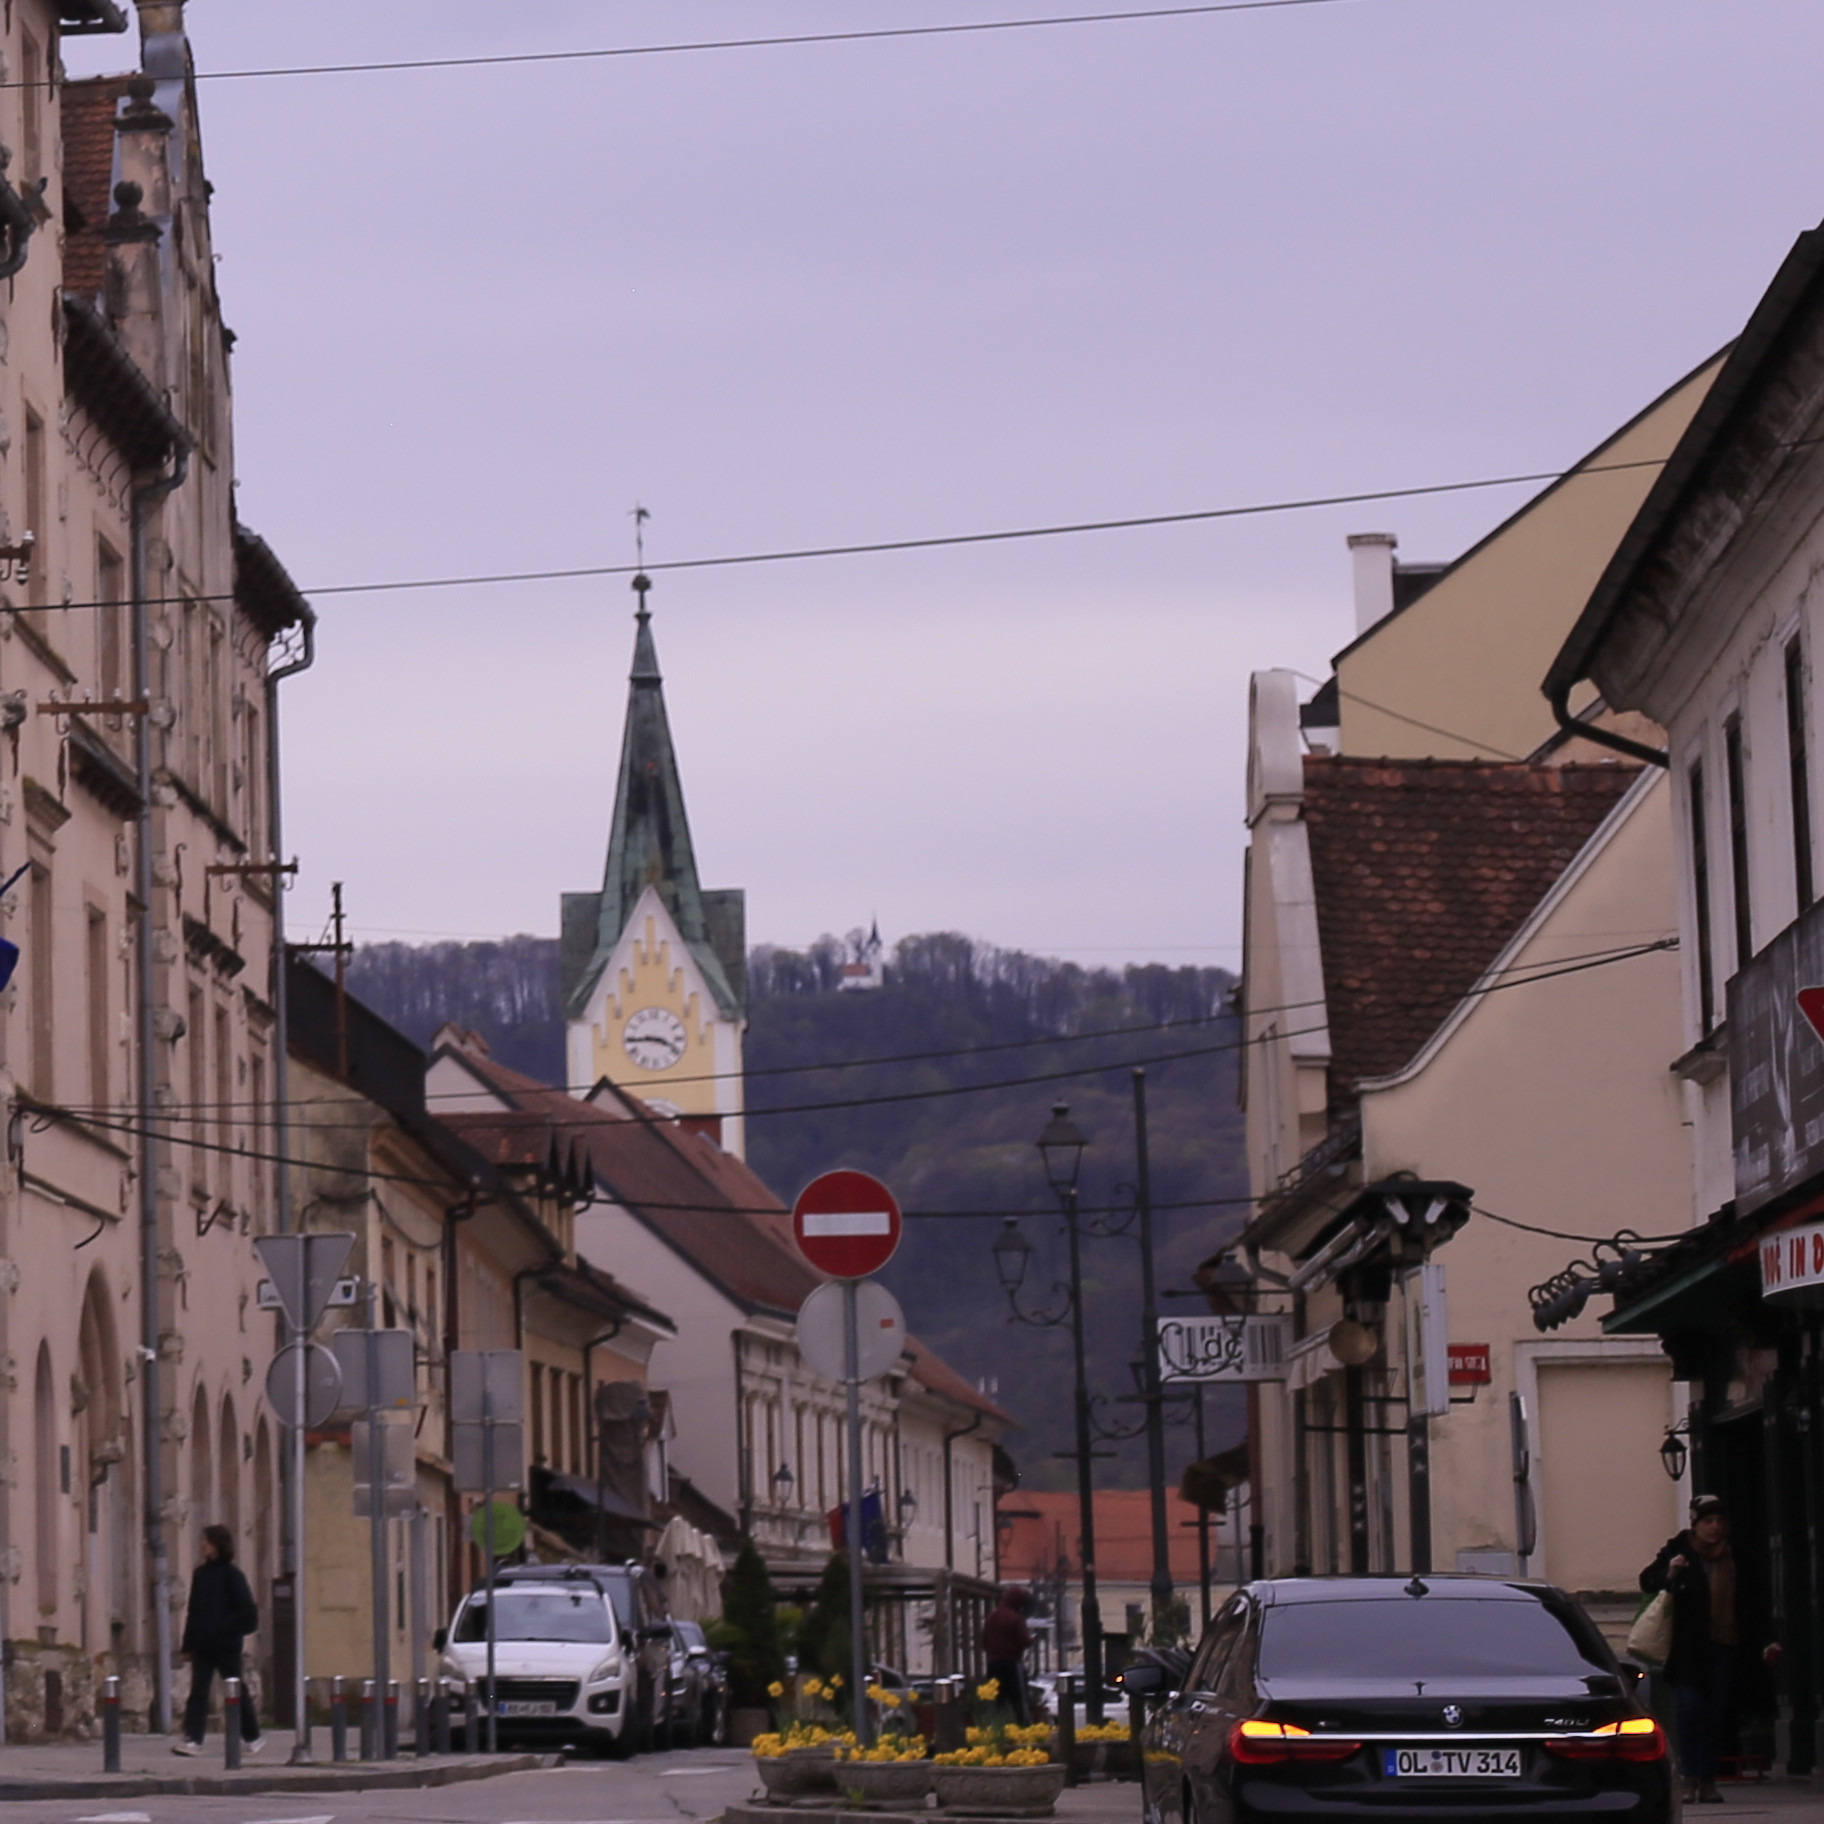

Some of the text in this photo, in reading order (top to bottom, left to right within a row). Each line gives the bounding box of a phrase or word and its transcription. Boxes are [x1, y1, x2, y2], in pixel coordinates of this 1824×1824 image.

[1790, 1235, 1806, 1280] IN
[1813, 1232, 1824, 1275] D
[1398, 1752, 1519, 1774] OL TV 314
